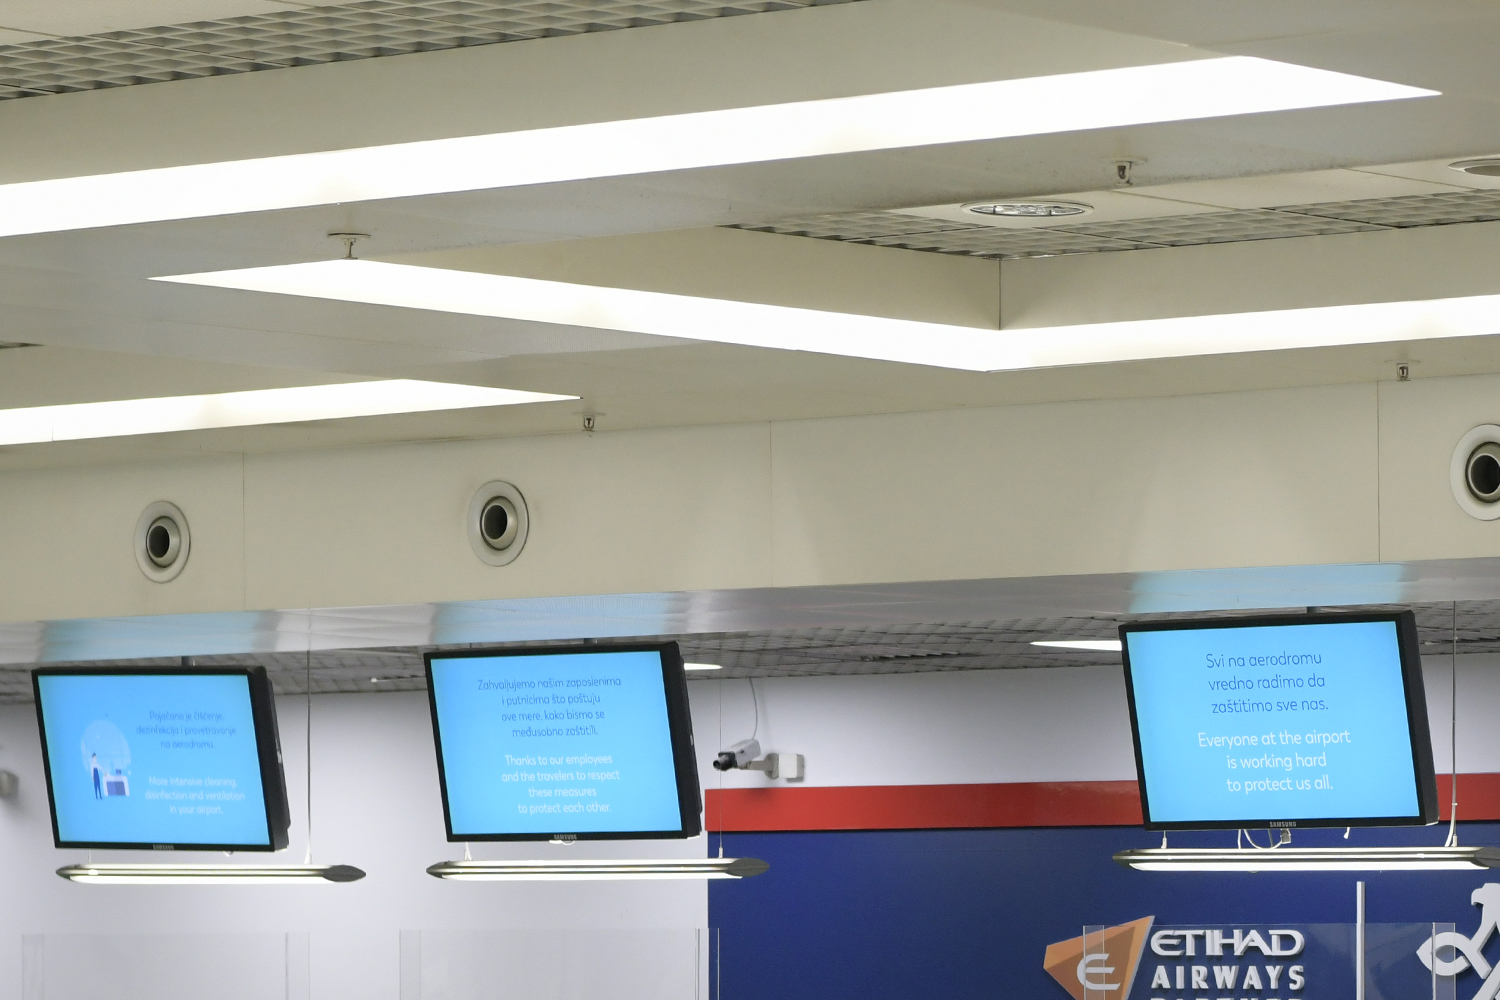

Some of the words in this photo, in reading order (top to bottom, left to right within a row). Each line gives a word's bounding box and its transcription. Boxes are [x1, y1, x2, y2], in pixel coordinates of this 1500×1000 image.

[1206, 653, 1224, 669] Svi
[1229, 654, 1245, 667] na
[1249, 651, 1322, 666] aerodromu
[478, 679, 535, 692] Zahvaljujemo
[538, 680, 564, 688] našim
[566, 677, 621, 689] zaposlenima
[1209, 676, 1253, 690] vredno
[1258, 675, 1304, 689] radimo
[1308, 673, 1325, 688] da
[506, 693, 549, 706] putnicima
[552, 692, 565, 704] što
[568, 693, 600, 705] poštuju
[1212, 699, 1272, 714] zaštitimo
[1277, 700, 1297, 712] sve
[1302, 698, 1328, 711] nas.
[502, 712, 517, 721] ove
[519, 711, 542, 722] mere,
[544, 710, 564, 720] kako
[567, 709, 593, 720] bismo
[596, 710, 604, 719] se
[512, 726, 563, 737] međusobno
[565, 725, 598, 736] zaštitili.
[1198, 733, 1258, 749] Everyone
[1262, 733, 1276, 745] at
[1280, 731, 1301, 745] the
[1305, 729, 1351, 747] airport
[504, 755, 536, 766] Thanks
[538, 756, 548, 765] to
[550, 756, 564, 765] our
[566, 755, 612, 767] employees
[1227, 756, 1237, 769] is
[1241, 754, 1292, 771] working
[1296, 752, 1326, 767] hard
[502, 772, 519, 782] and
[521, 771, 535, 781] the
[537, 770, 574, 781] travelers
[576, 771, 586, 780] to
[588, 770, 620, 783] respect
[529, 787, 552, 797] these
[555, 787, 596, 797] measures
[1227, 779, 1241, 791] to
[1245, 777, 1292, 794] protect
[1296, 778, 1311, 790] us
[1315, 775, 1333, 789] all.
[518, 803, 527, 813] to
[530, 802, 560, 815] protect
[563, 802, 584, 813] each
[587, 802, 612, 813] other.
[1150, 930, 1303, 957] ETIHAD
[1150, 965, 1305, 990] AIRWAYS
